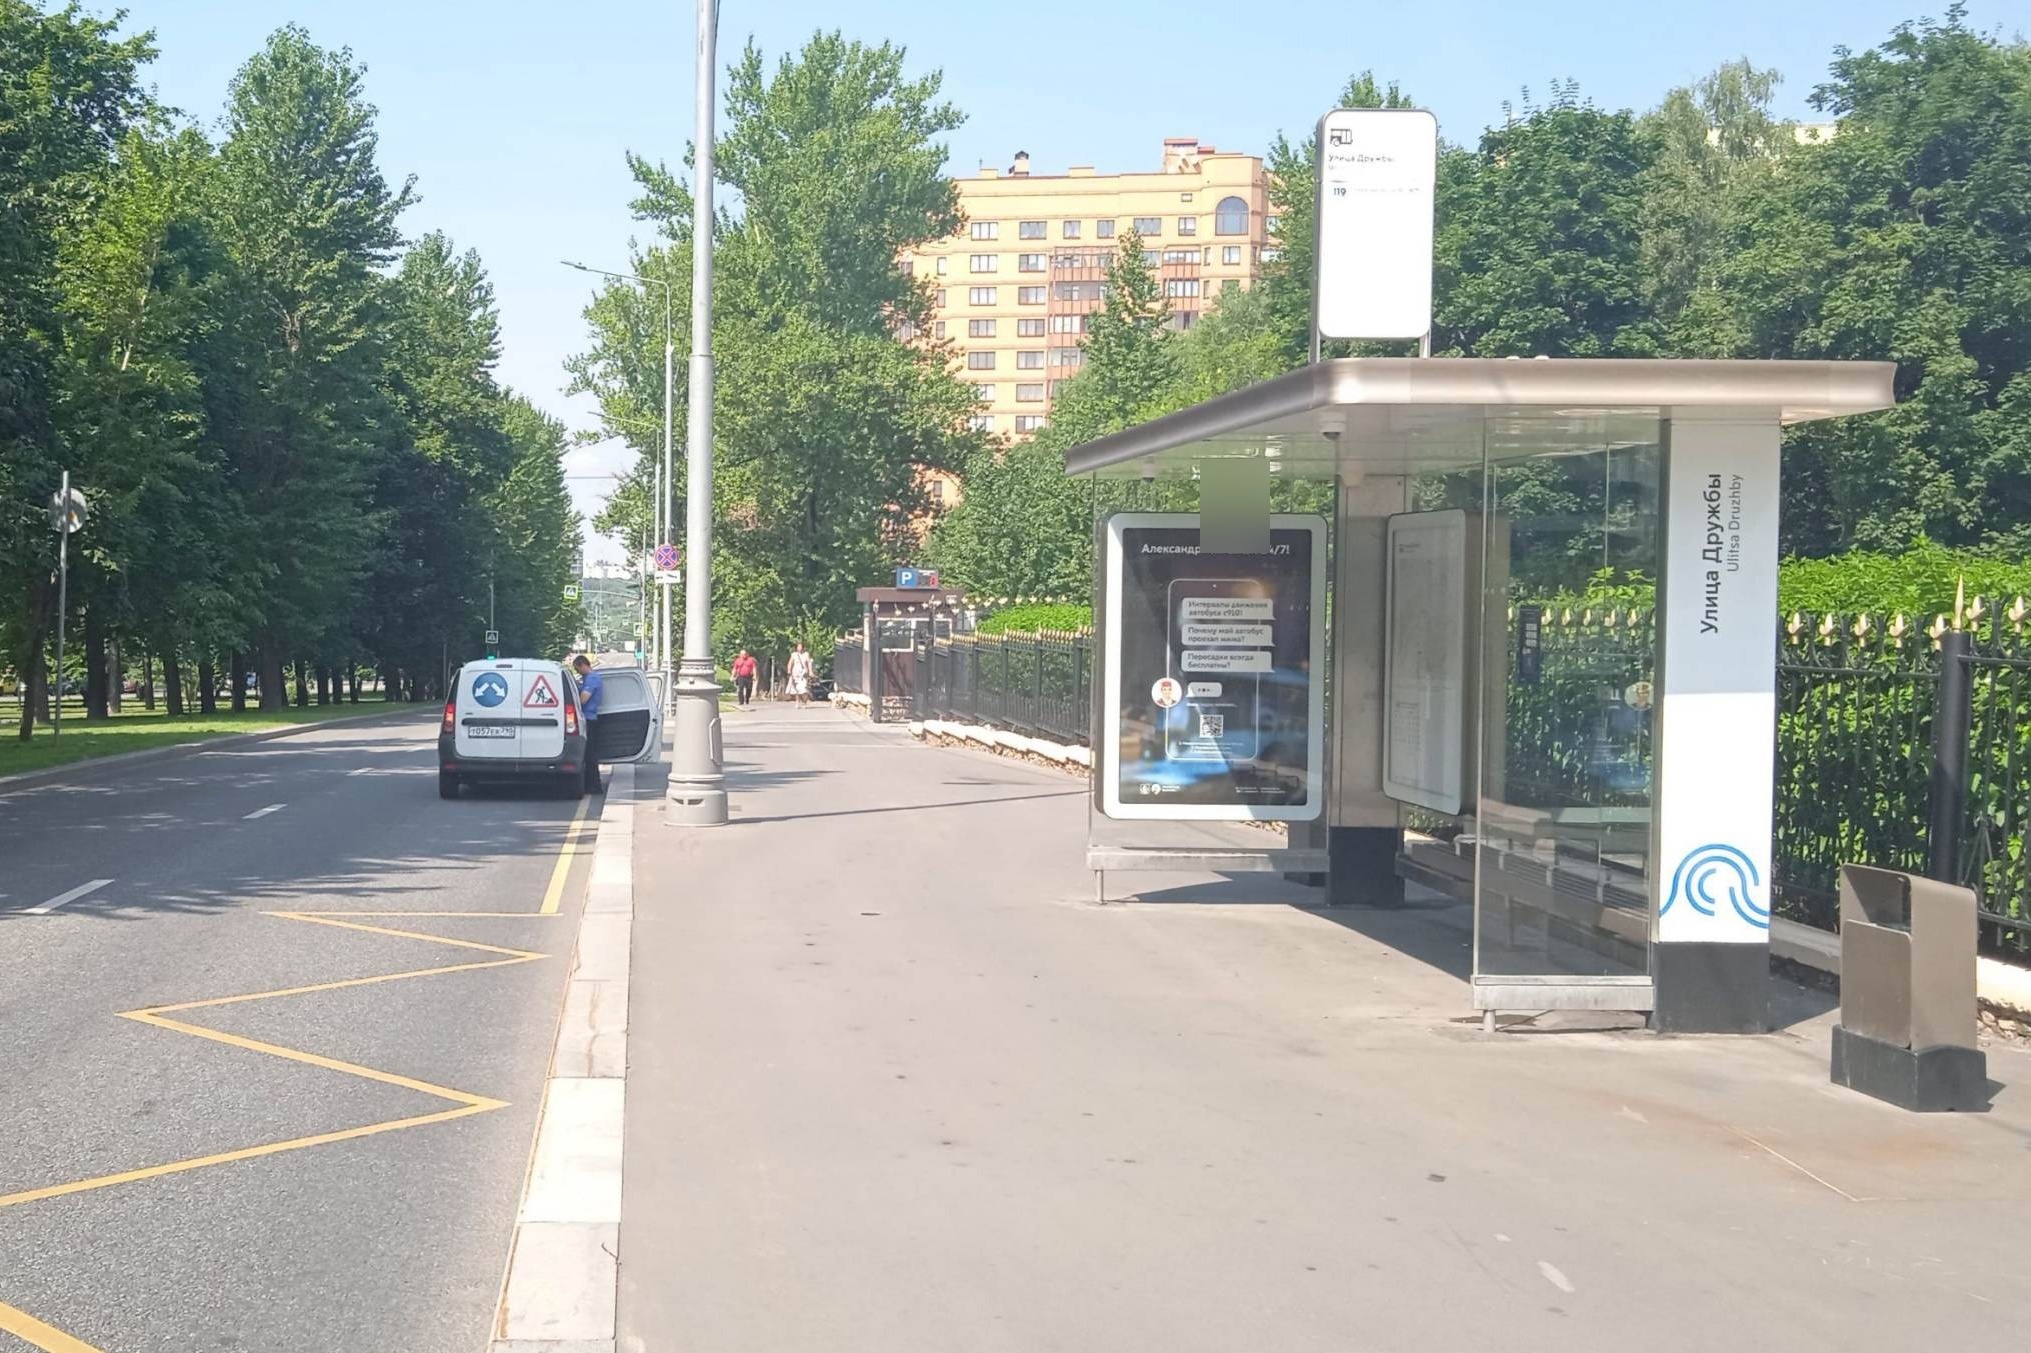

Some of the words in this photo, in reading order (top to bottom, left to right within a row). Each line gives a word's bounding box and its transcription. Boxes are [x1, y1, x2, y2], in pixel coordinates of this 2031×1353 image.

[1333, 188, 1346, 196] 119
[1729, 474, 1744, 530] Druzhby
[1702, 474, 1724, 563] Дружбы
[1727, 534, 1740, 572] Ulitsa
[901, 571, 912, 585] P
[1700, 570, 1721, 633] Улица
[1188, 609, 1221, 617] автобуса
[1188, 626, 1217, 635] Почему
[1235, 627, 1264, 635] автобус
[1187, 653, 1228, 661] Пересадки
[1229, 654, 1254, 662] всегда
[1187, 661, 1231, 669] бесплатны?
